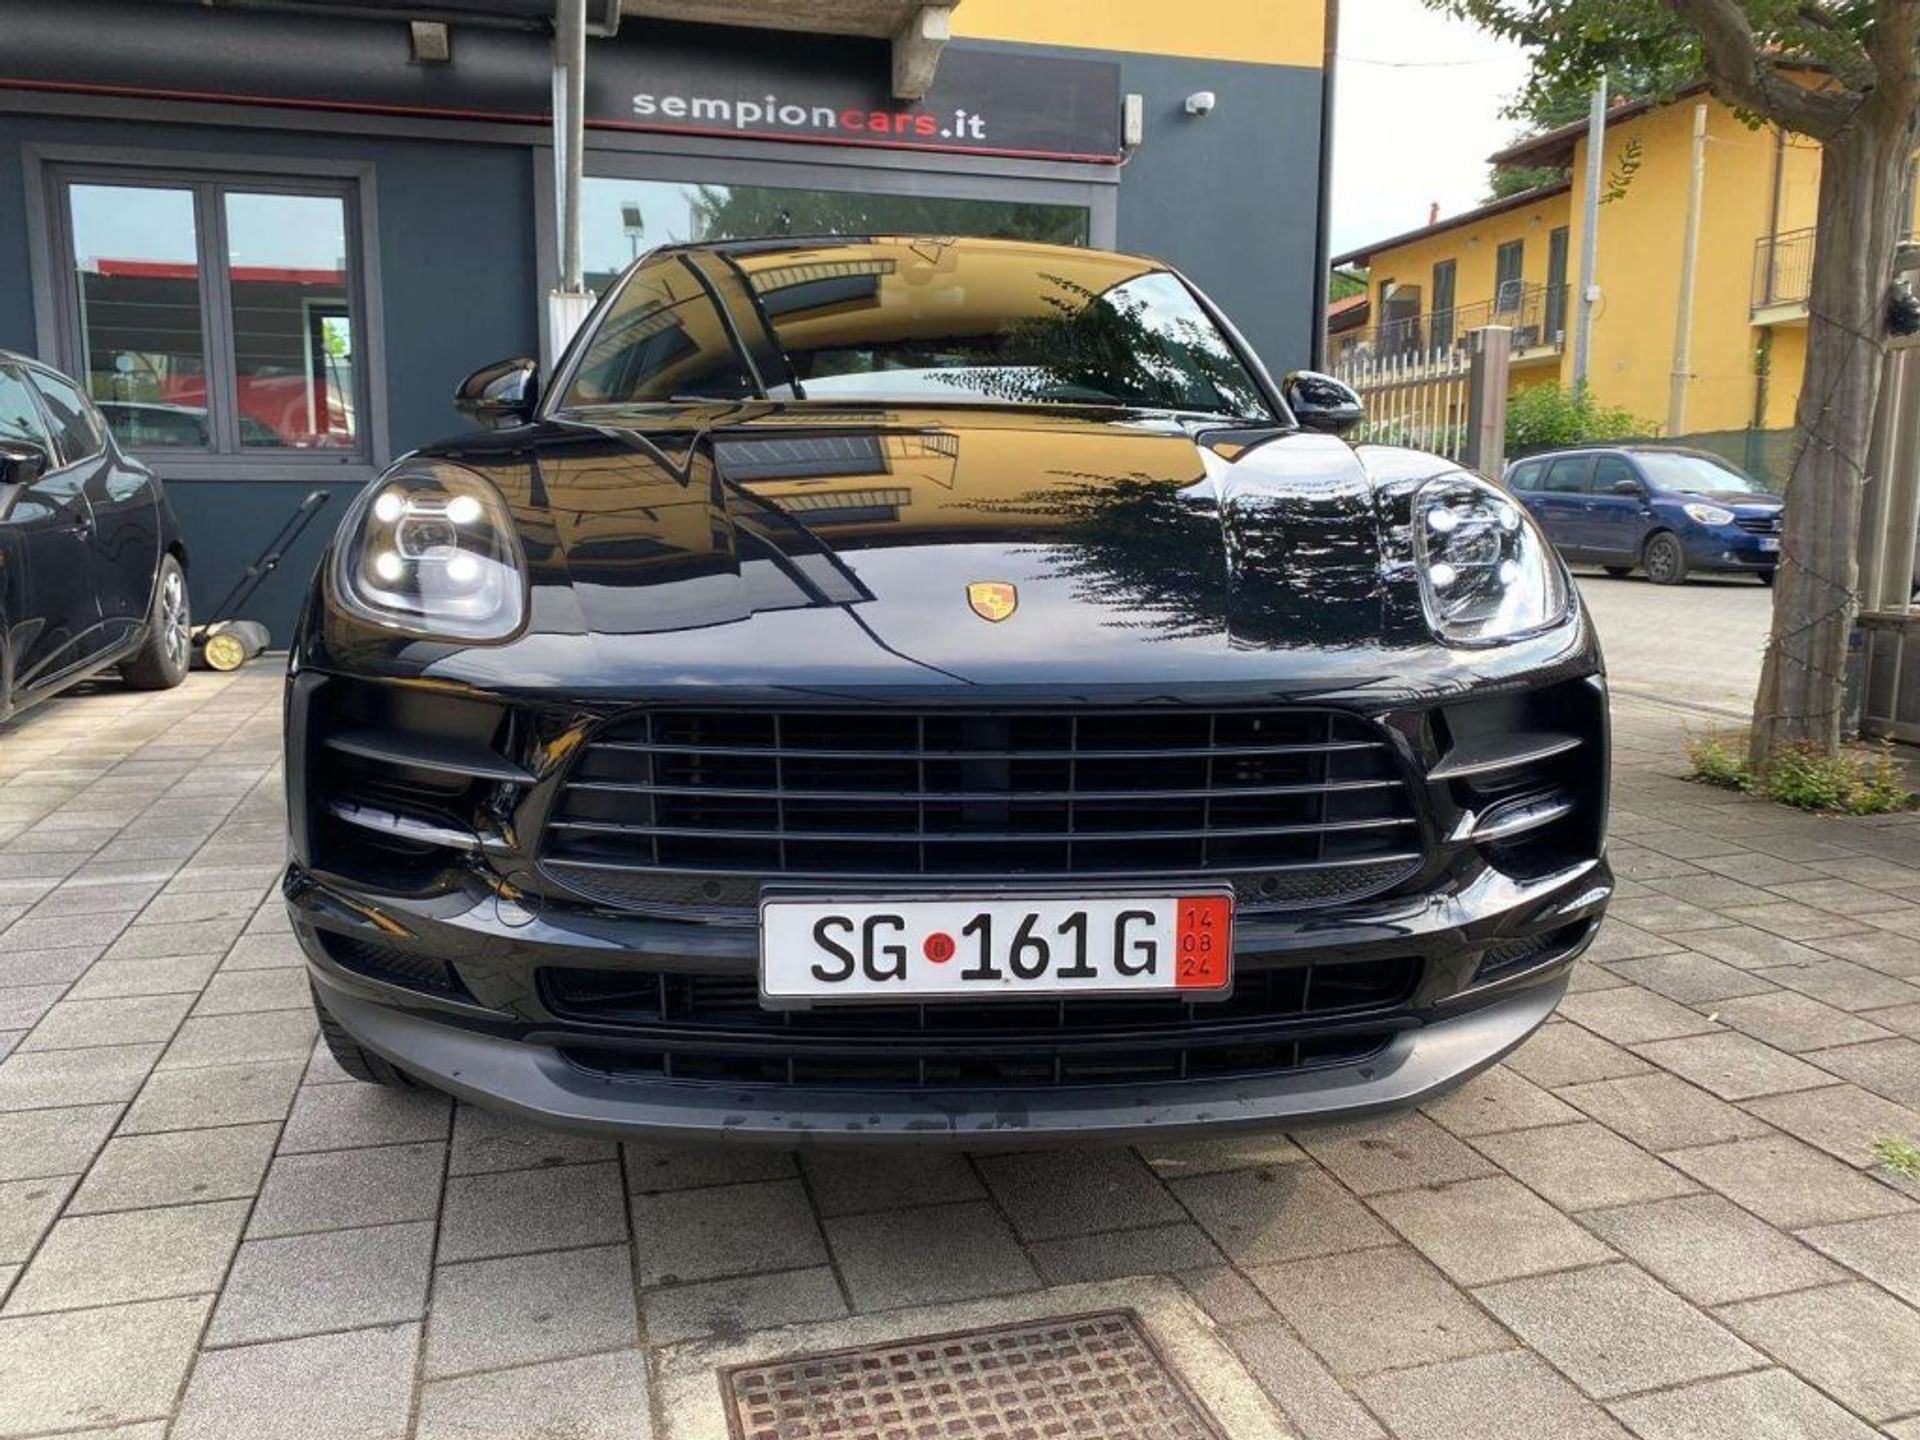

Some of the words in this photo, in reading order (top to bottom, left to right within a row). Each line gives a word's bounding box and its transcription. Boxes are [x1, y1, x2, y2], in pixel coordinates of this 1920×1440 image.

[632, 93, 986, 139] sempioncars.it
[1187, 907, 1213, 928] 14
[811, 914, 907, 982] SG
[1183, 933, 1212, 952] 08
[1183, 957, 1211, 976] 24
